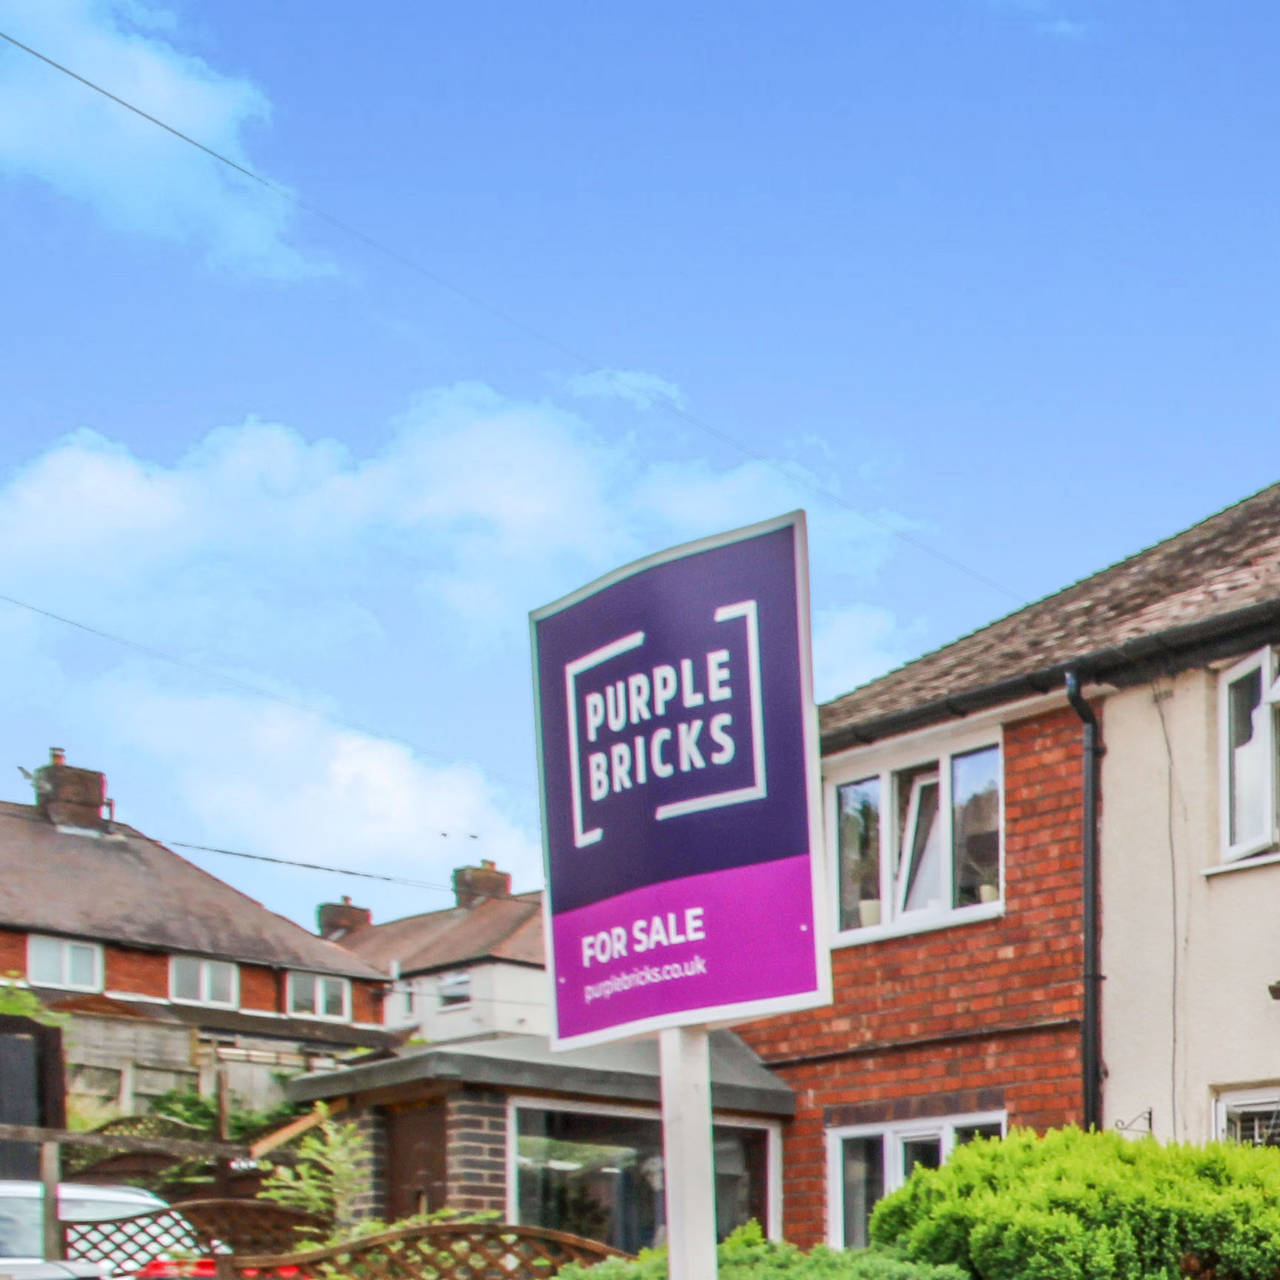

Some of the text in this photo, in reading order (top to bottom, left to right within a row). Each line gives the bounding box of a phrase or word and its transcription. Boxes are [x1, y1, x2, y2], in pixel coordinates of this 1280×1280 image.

[585, 649, 732, 742] PURPLE
[588, 713, 735, 801] BRICKS
[582, 906, 706, 968] FOR SALE
[584, 955, 707, 1004] purplebricks.co.uk
